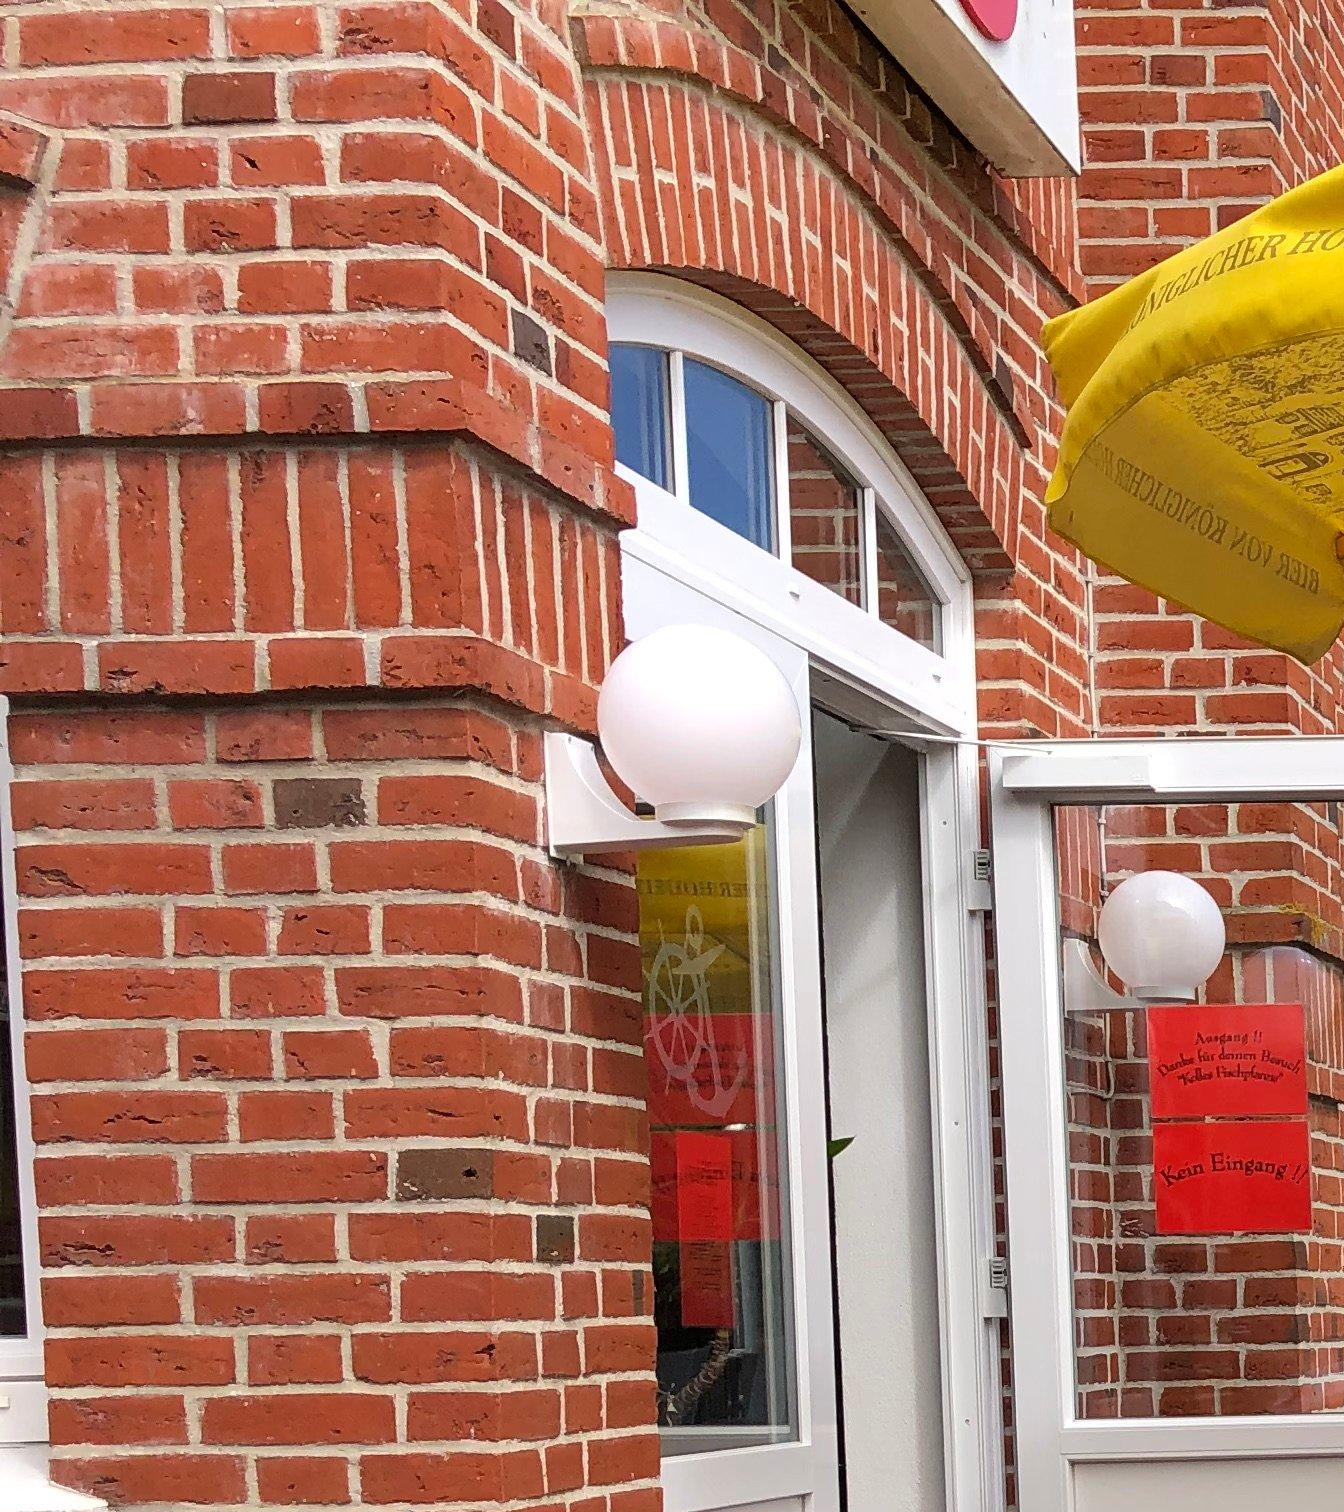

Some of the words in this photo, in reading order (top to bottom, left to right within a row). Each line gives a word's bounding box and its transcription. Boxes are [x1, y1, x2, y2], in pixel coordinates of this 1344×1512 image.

[1194, 1031, 1248, 1046] Ausgang
[1156, 1052, 1195, 1077] Danke
[1197, 1047, 1216, 1063] für
[1261, 1049, 1302, 1075] Besuch
[1159, 1161, 1206, 1188] Kein
[1210, 1152, 1289, 1181] Eingang
[1291, 1164, 1309, 1185] !!
